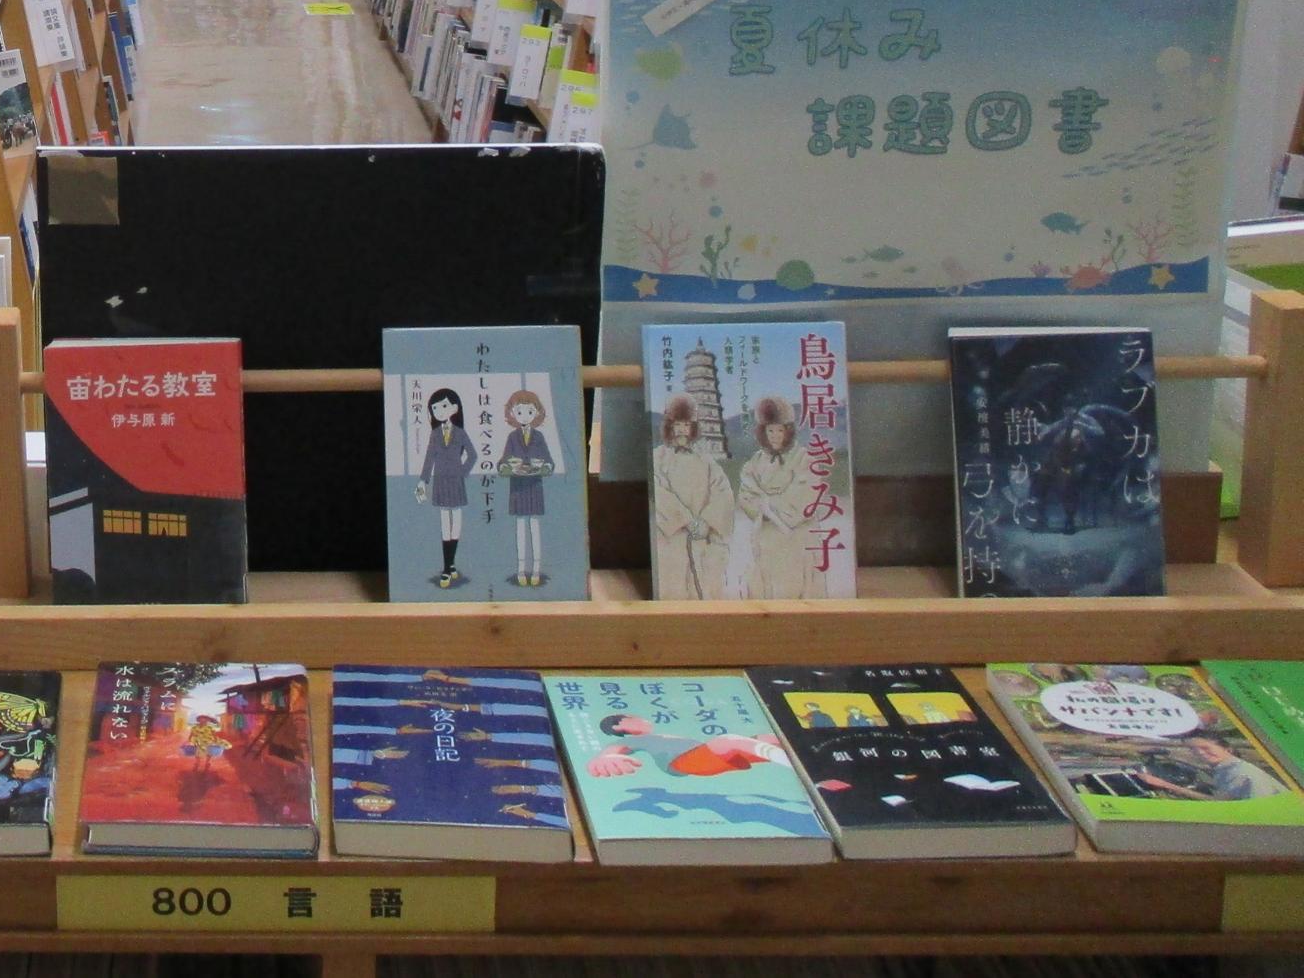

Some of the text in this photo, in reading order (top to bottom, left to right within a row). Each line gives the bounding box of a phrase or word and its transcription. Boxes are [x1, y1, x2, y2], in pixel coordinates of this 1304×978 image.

[727, 3, 943, 77] 夏休み
[805, 86, 1110, 158] 課題図書
[66, 370, 218, 401] 宙わたる教室
[111, 411, 177, 429] 伊与原 新
[475, 342, 496, 525] わたしは食べるのが下手
[1119, 339, 1161, 504] ラブカは
[796, 333, 847, 573] 鳥居きみ子
[1004, 405, 1042, 526] 静かに
[962, 462, 1001, 598] 弓を持
[110, 665, 136, 740] 水は流れない
[155, 666, 179, 711] スラムに
[556, 681, 589, 711] 世界
[599, 682, 629, 710] 見る
[639, 682, 680, 725] ぼくが
[682, 682, 728, 736] コーダの
[429, 707, 461, 762] 夜の日記
[151, 885, 405, 921] 800 言語
